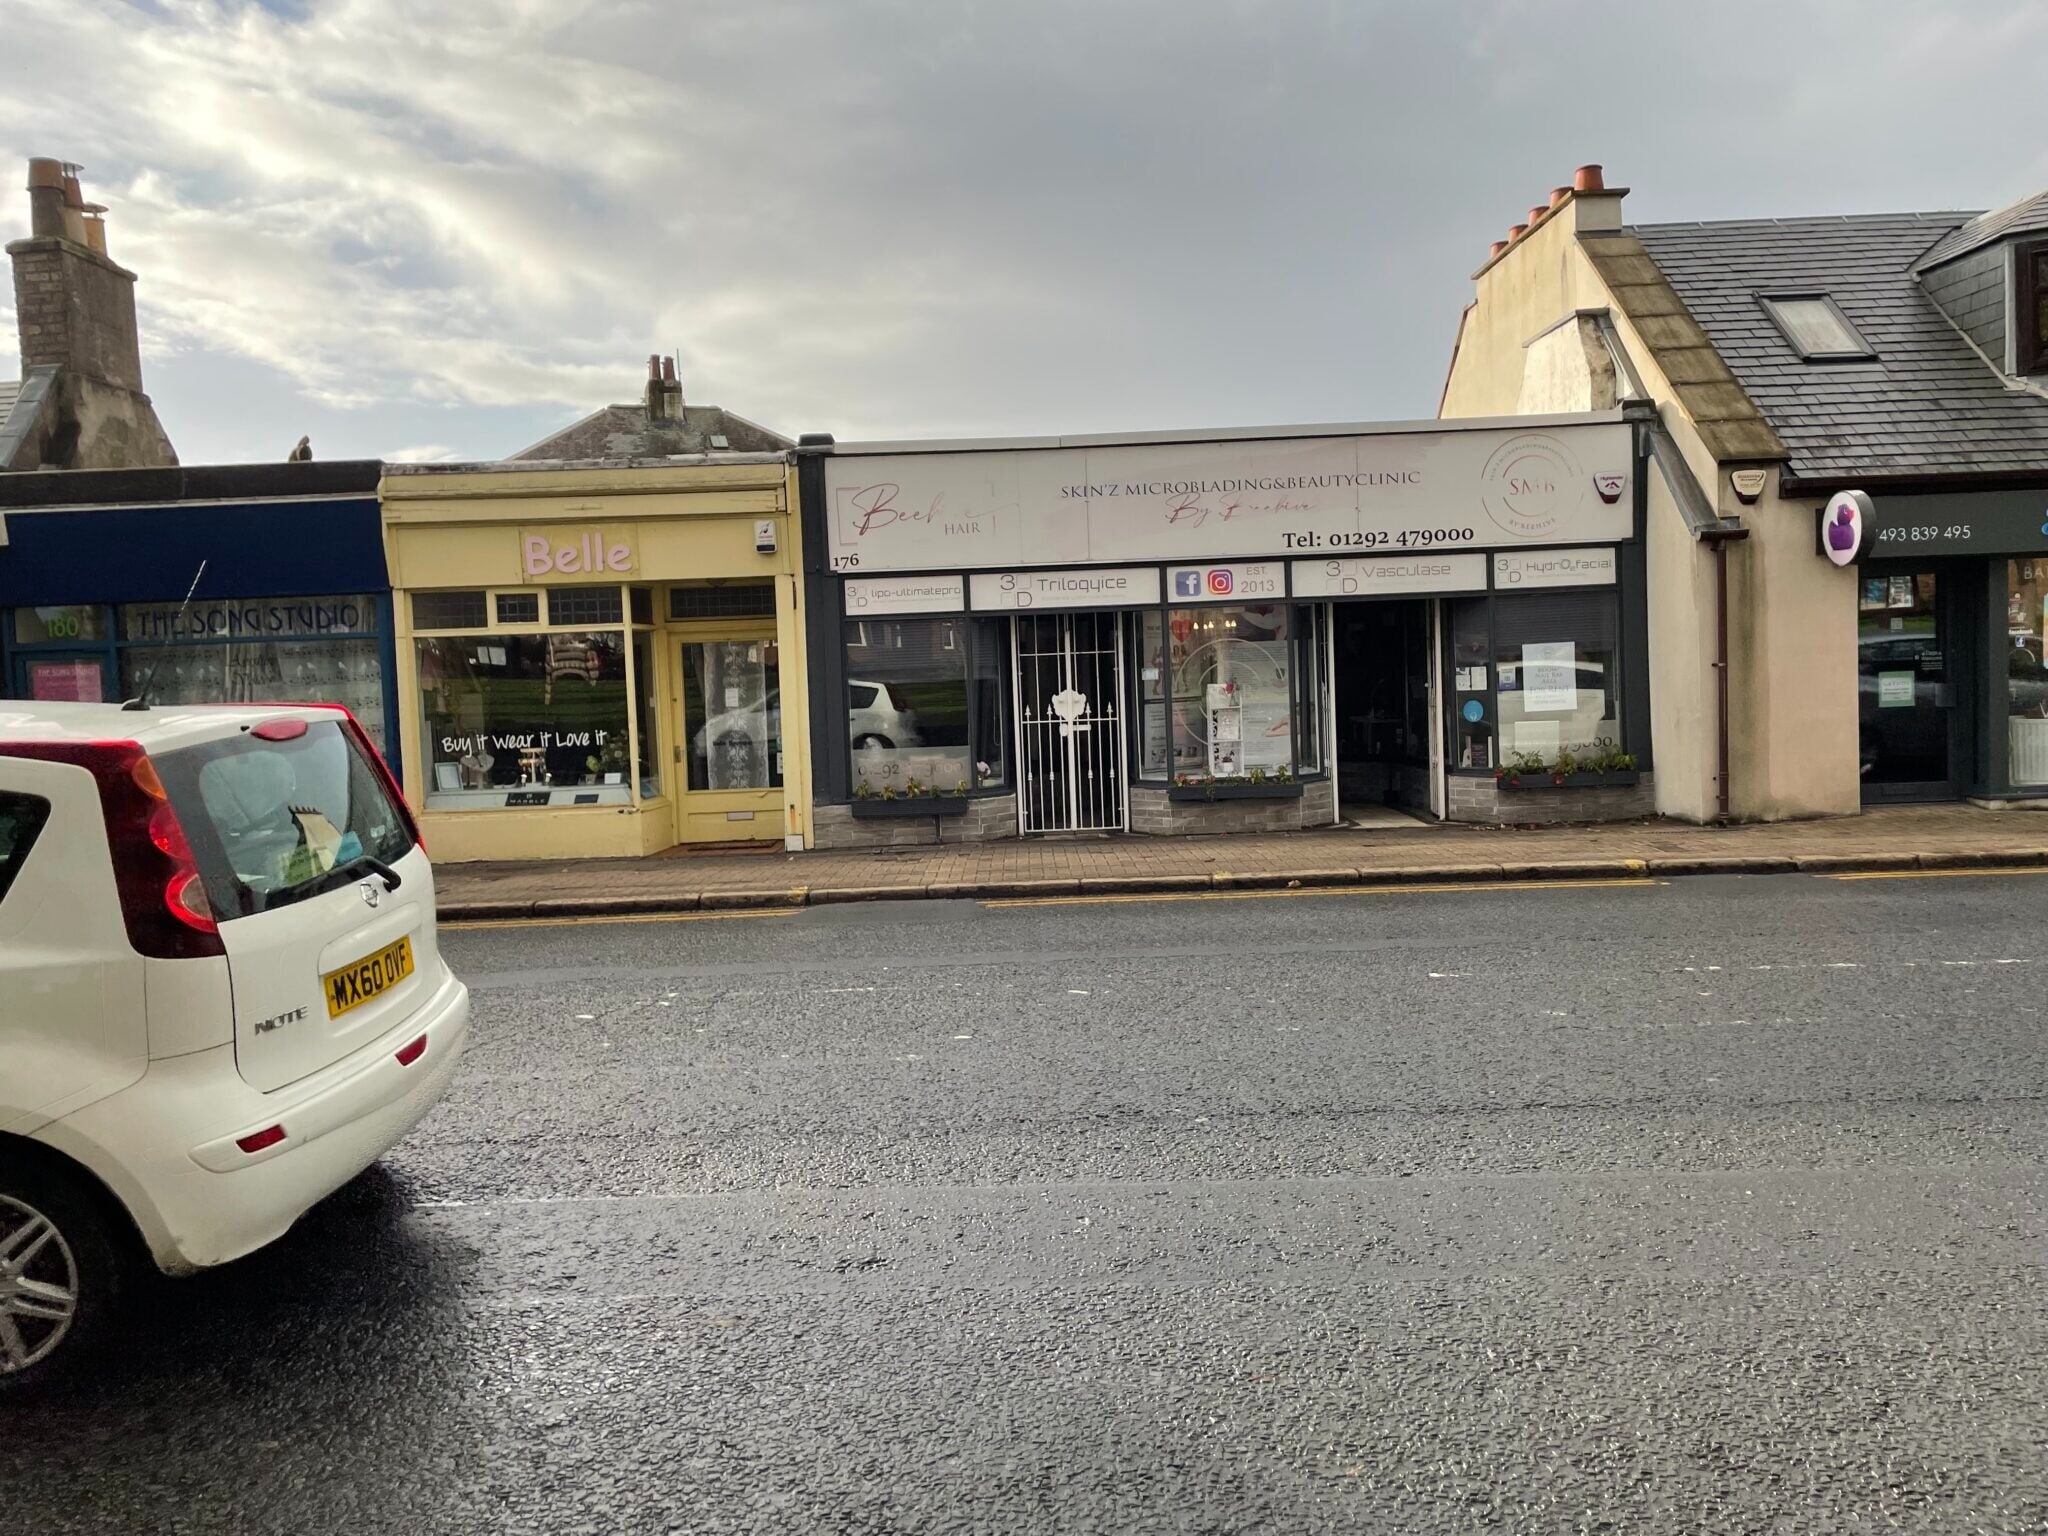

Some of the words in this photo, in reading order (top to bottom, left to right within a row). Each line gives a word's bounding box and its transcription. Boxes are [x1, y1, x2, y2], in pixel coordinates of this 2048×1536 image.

[1061, 484, 1118, 499] SKIN'Z
[1165, 491, 1212, 528] By
[945, 522, 982, 537] HAIR
[1282, 532, 1321, 548] Tel:
[1329, 531, 1389, 548] 01292
[1396, 527, 1474, 547] 479000
[1911, 526, 1939, 541] 839
[1943, 525, 1971, 540] 495
[525, 531, 633, 576] Belle
[833, 553, 860, 569] 176
[1362, 563, 1451, 578] Vasculase
[871, 584, 961, 599] lipo-ultimatepro
[1240, 580, 1275, 594] 2013
[48, 616, 79, 637] 180
[138, 610, 185, 637] THE
[191, 608, 261, 634] SONG
[269, 603, 360, 632] STUDIO
[442, 735, 472, 758] Buy
[476, 734, 488, 750] it
[492, 732, 535, 750] Wear
[540, 731, 552, 748] it
[555, 731, 590, 748] Love
[596, 729, 608, 746] it
[333, 960, 384, 1010] MX60
[385, 943, 406, 984] OVF
[254, 1005, 309, 1036] NOTE
